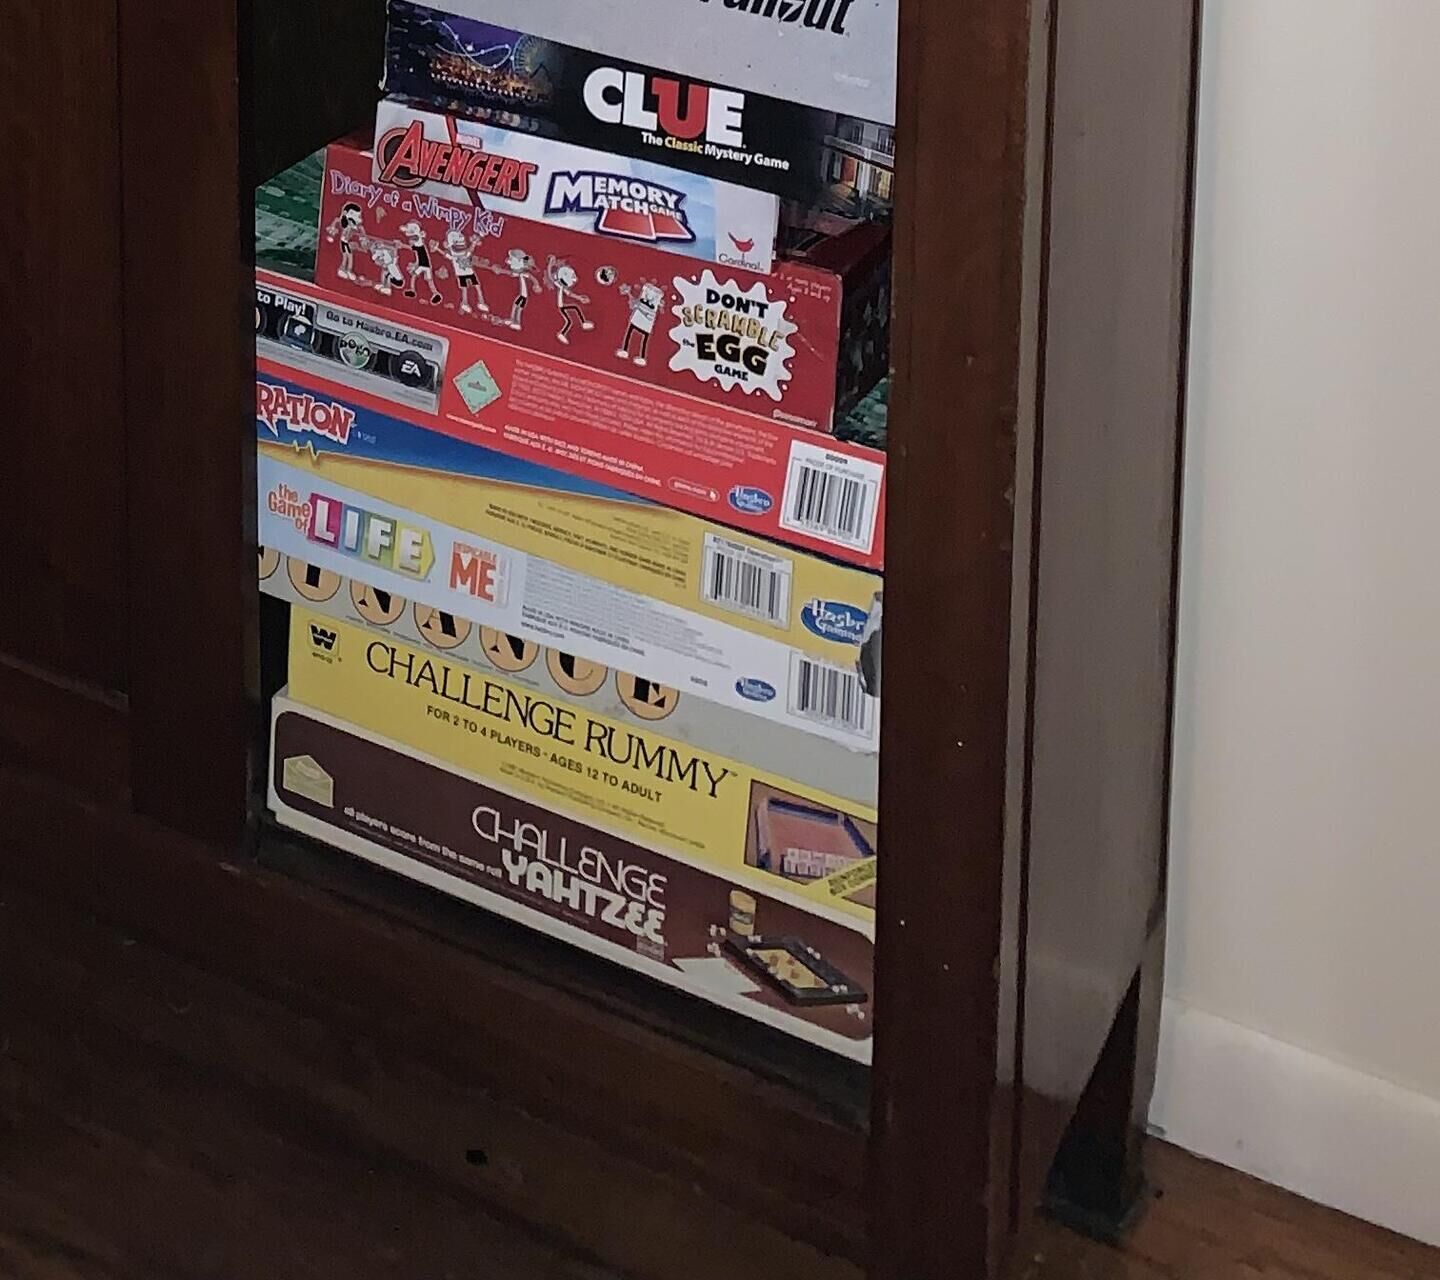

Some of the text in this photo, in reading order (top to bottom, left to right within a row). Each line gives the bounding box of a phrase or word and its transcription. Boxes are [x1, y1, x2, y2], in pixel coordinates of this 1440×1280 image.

[582, 66, 744, 148] CLUE
[380, 122, 538, 201] AVENGERS
[641, 131, 790, 171] The Classic Mystery Game
[329, 169, 505, 238] Diary of Wimpy Kid
[549, 171, 681, 211] MEMORY
[718, 252, 762, 272] Cardinal
[256, 290, 307, 316] to Play!
[326, 310, 340, 323] Go
[342, 316, 354, 328] to
[706, 288, 769, 319] DON'T
[681, 306, 785, 352] SCRAMBLE
[400, 360, 422, 377] EA
[695, 333, 770, 376] EGG
[714, 363, 749, 381] GAME
[268, 489, 310, 519] Game
[278, 483, 299, 503] the
[294, 515, 310, 535] of
[313, 497, 425, 574] LIFE
[453, 542, 498, 564] DESPICABLE
[449, 552, 498, 602] ME
[366, 640, 578, 746] CHALLENGE
[583, 718, 730, 799] RUMMY
[426, 704, 663, 803] FOR 2 TO 4 PLAYERS AGES 12 TO ADULT
[355, 811, 441, 853] players from
[471, 805, 669, 910] CHALLENGE
[501, 848, 666, 945] YAHTZEE
